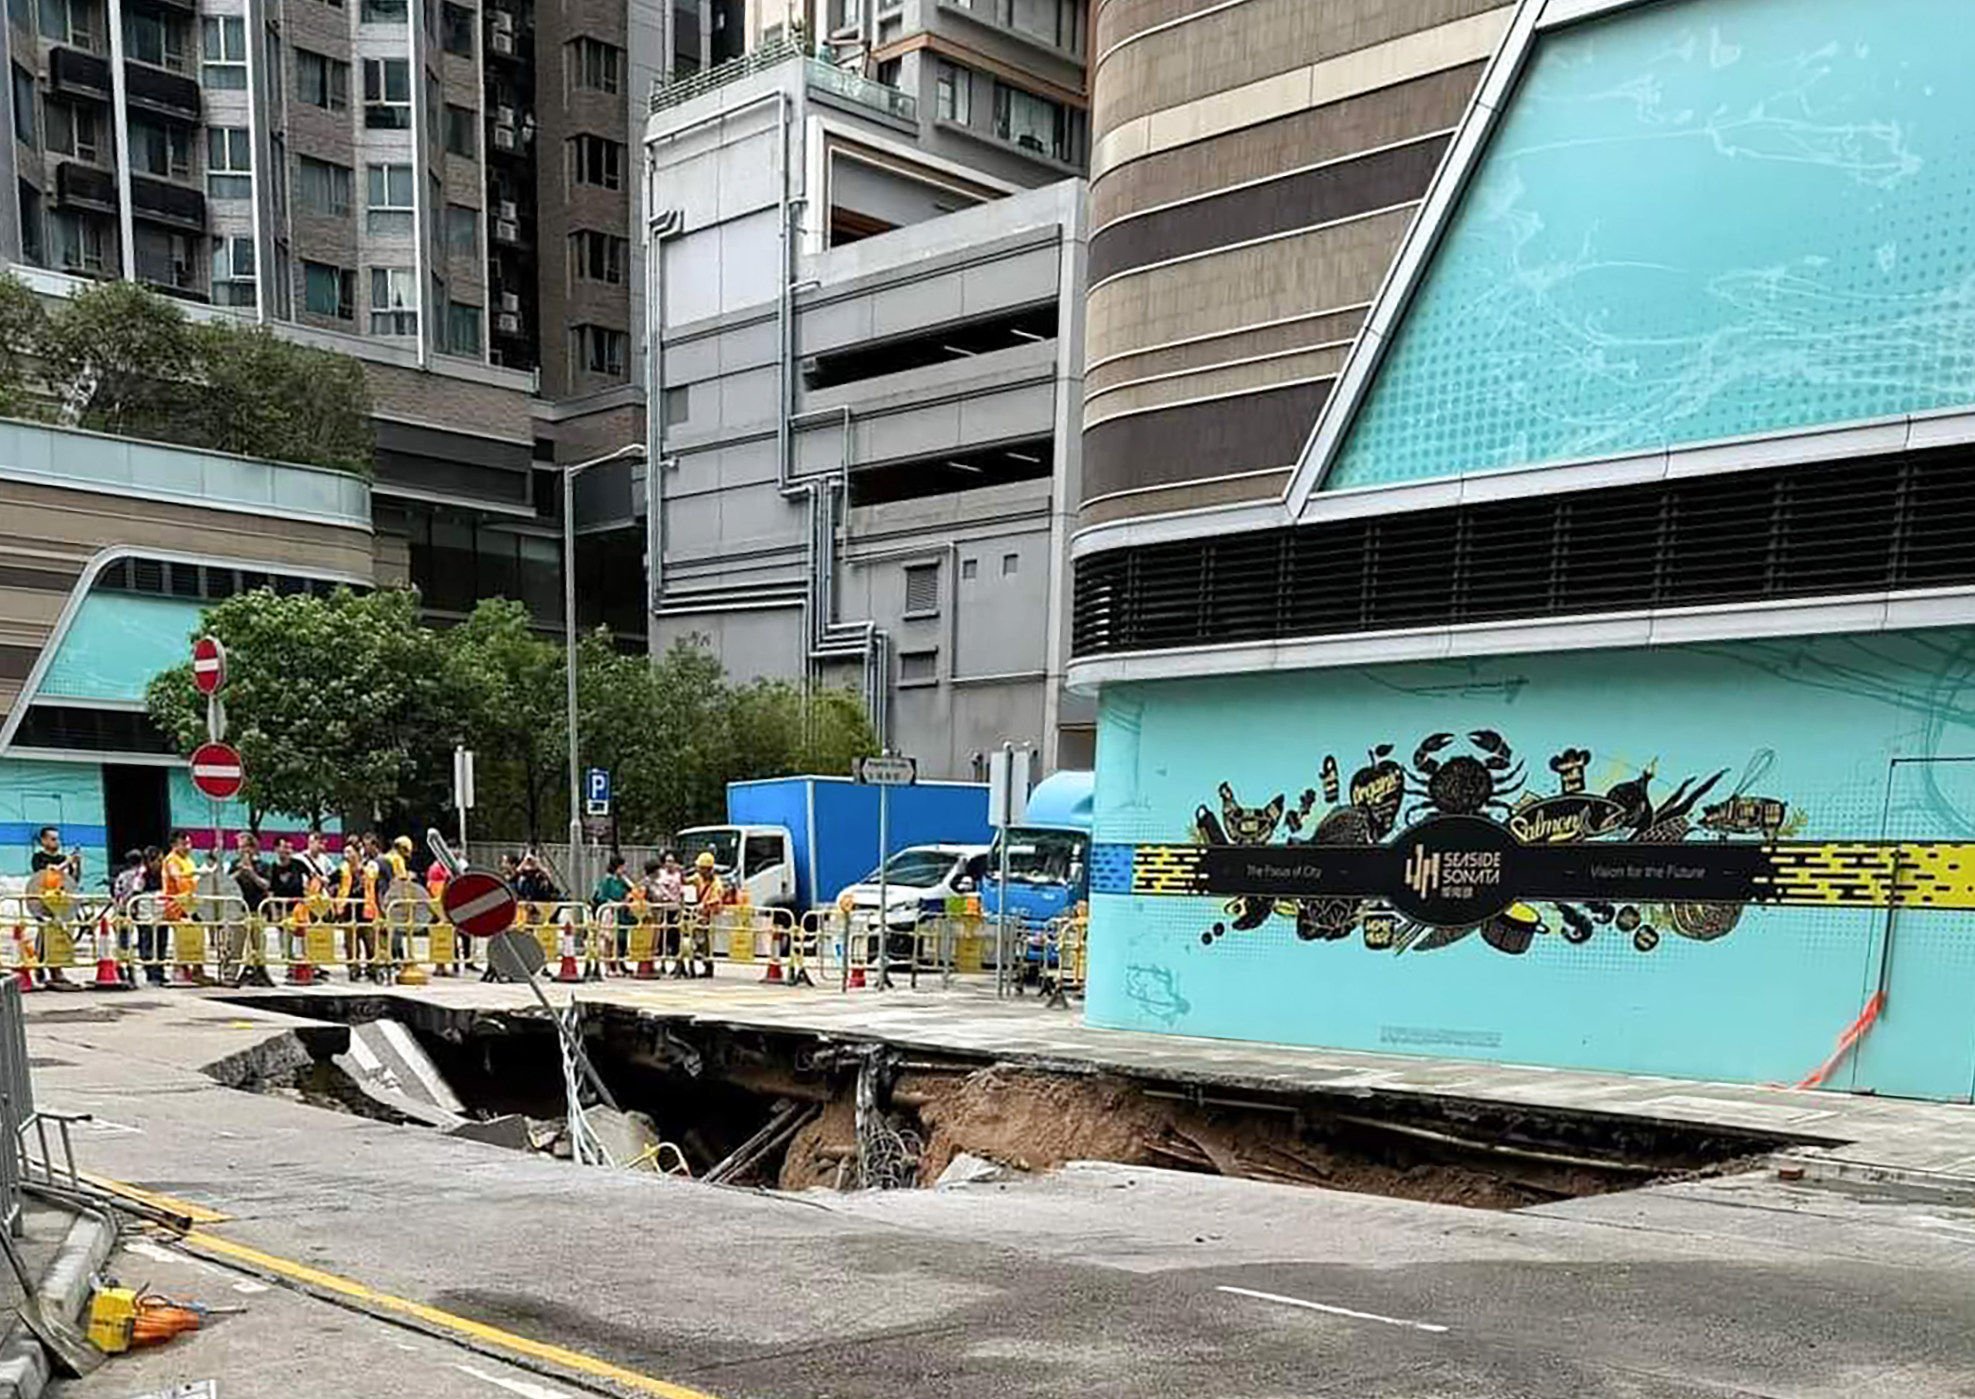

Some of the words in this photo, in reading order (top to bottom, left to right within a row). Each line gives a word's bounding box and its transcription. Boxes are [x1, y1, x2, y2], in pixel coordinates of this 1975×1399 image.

[592, 774, 605, 799] P
[1443, 852, 1500, 867] SEASIDE
[1443, 869, 1500, 884] SONATA
